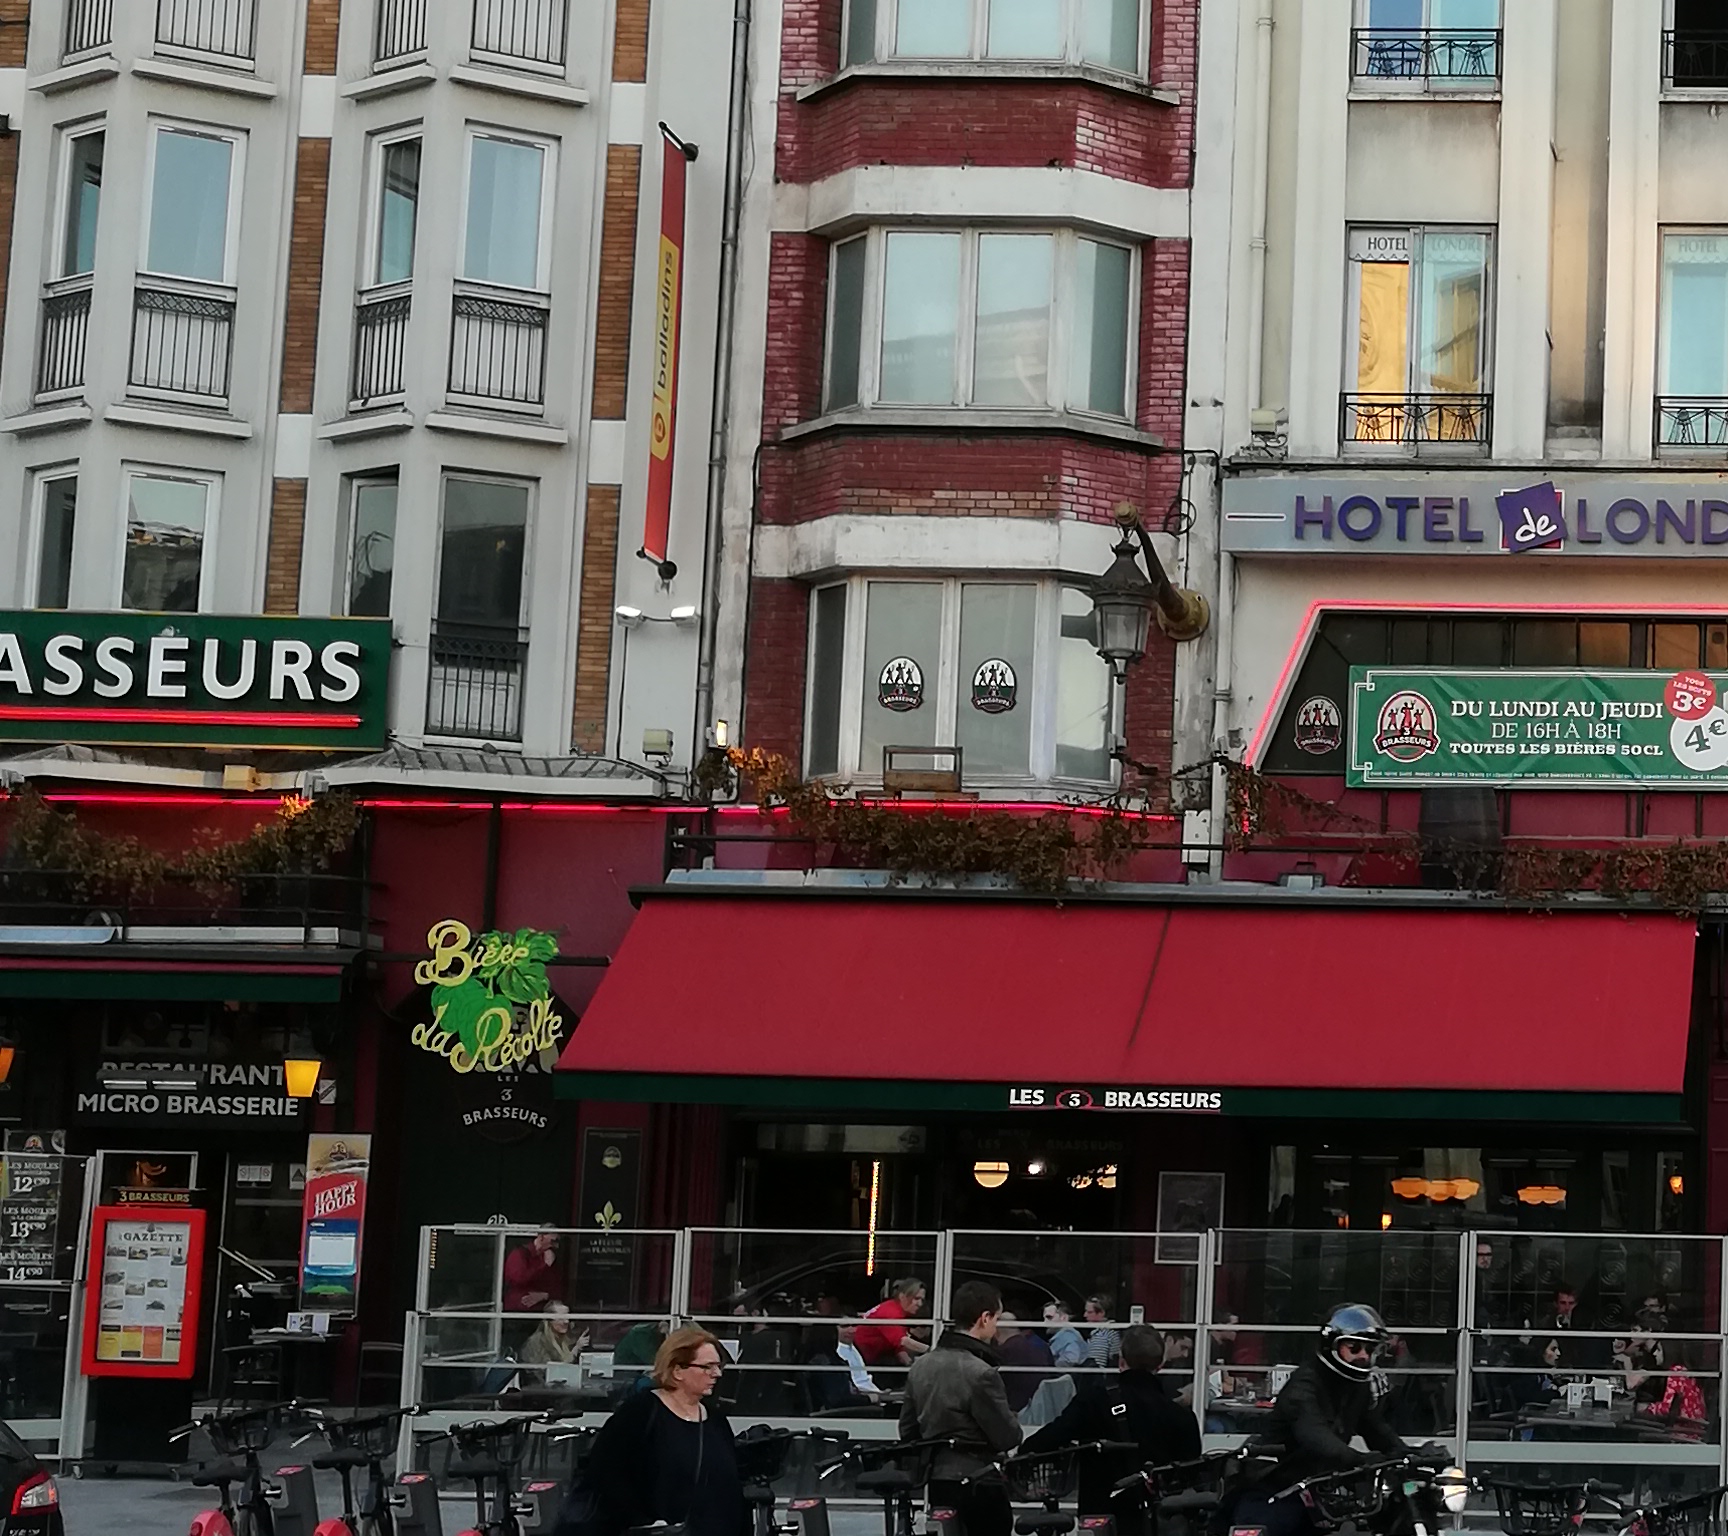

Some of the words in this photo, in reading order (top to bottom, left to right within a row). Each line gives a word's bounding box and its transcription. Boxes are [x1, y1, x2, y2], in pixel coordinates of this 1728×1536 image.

[1368, 237, 1407, 253] HOTEL
[1678, 238, 1719, 253] HOTEL
[657, 251, 673, 389] balladins
[1295, 495, 1484, 543] HOTEL
[1514, 507, 1558, 542] de
[0, 633, 361, 702] ASSEURS
[1451, 701, 1484, 717] DU
[1489, 701, 1559, 717] LUNDI
[1563, 701, 1597, 718] AU
[1601, 702, 1663, 720] JEUDI
[1403, 727, 1411, 735] 3
[1491, 722, 1518, 739] DE
[1526, 722, 1560, 739] 16H
[1564, 719, 1581, 739] À
[1588, 723, 1622, 739] 18H
[1382, 736, 1432, 748] BRASSEURS
[1449, 743, 1515, 754] TOUTES
[1519, 743, 1550, 755] LES
[1621, 744, 1663, 756] 50CL
[500, 1088, 513, 1101] 3
[1009, 1088, 1045, 1106] LES
[1068, 1093, 1082, 1107] 3
[1104, 1091, 1222, 1109] BRASSEURS
[78, 1093, 159, 1113] MICRO
[167, 1095, 299, 1116] BRASSERIE
[463, 1107, 548, 1128] BRASSEURS
[119, 1191, 127, 1202] 3
[129, 1192, 190, 1203] BRASSEURS
[315, 1180, 358, 1207] HAPPY
[314, 1193, 357, 1218] HOUR
[124, 1233, 184, 1242] GAZETTE
